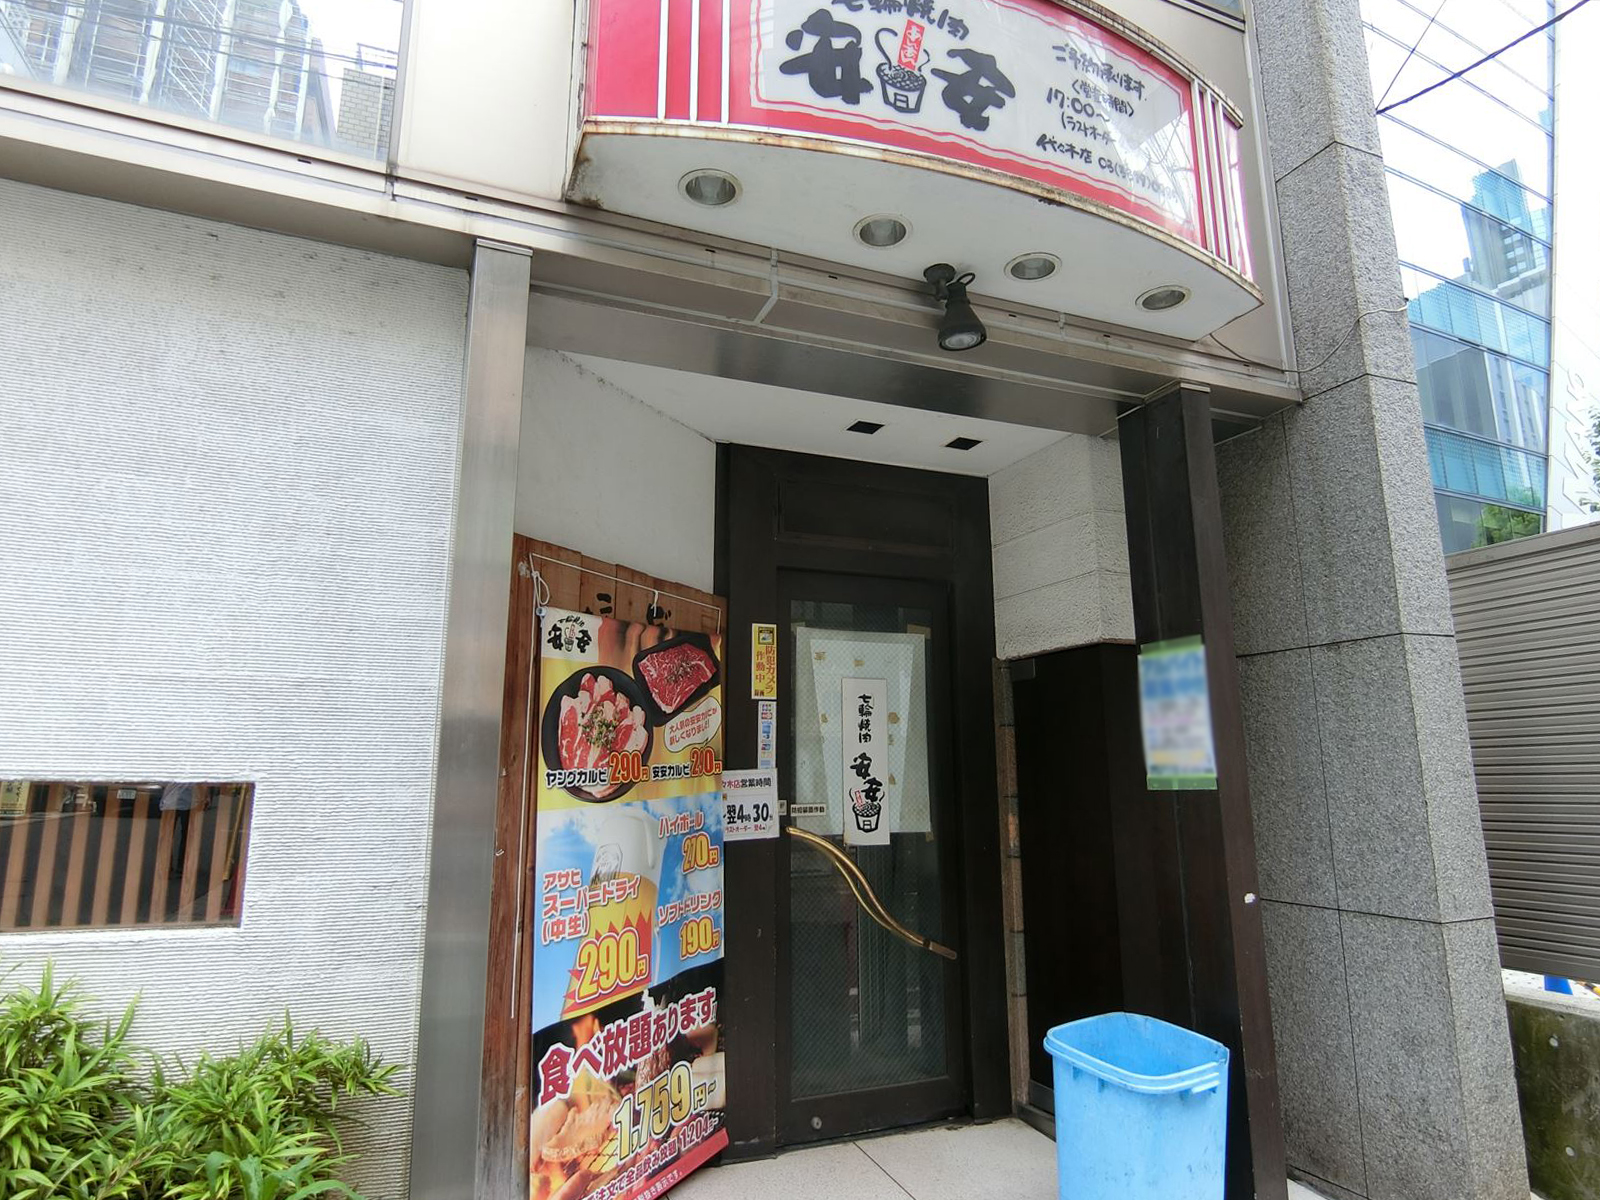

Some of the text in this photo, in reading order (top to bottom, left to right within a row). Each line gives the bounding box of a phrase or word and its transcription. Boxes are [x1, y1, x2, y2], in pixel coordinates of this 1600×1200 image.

[1036, 134, 1092, 164] 代々木店
[756, 650, 765, 683] 作動中
[765, 645, 775, 694] 防犯カメラ
[858, 693, 874, 744] 七輪焼肉
[546, 769, 609, 788] ヤングカルビ
[610, 751, 650, 784] 290円
[652, 760, 690, 778] 安安カルビ
[658, 812, 704, 838] ハイボール
[542, 875, 640, 917] スーパードライ
[543, 869, 582, 890] アサヒ
[657, 890, 722, 927] ソフトドリンク
[541, 911, 591, 945] (中生)
[679, 915, 721, 960] 190円
[576, 927, 648, 1002] 290円
